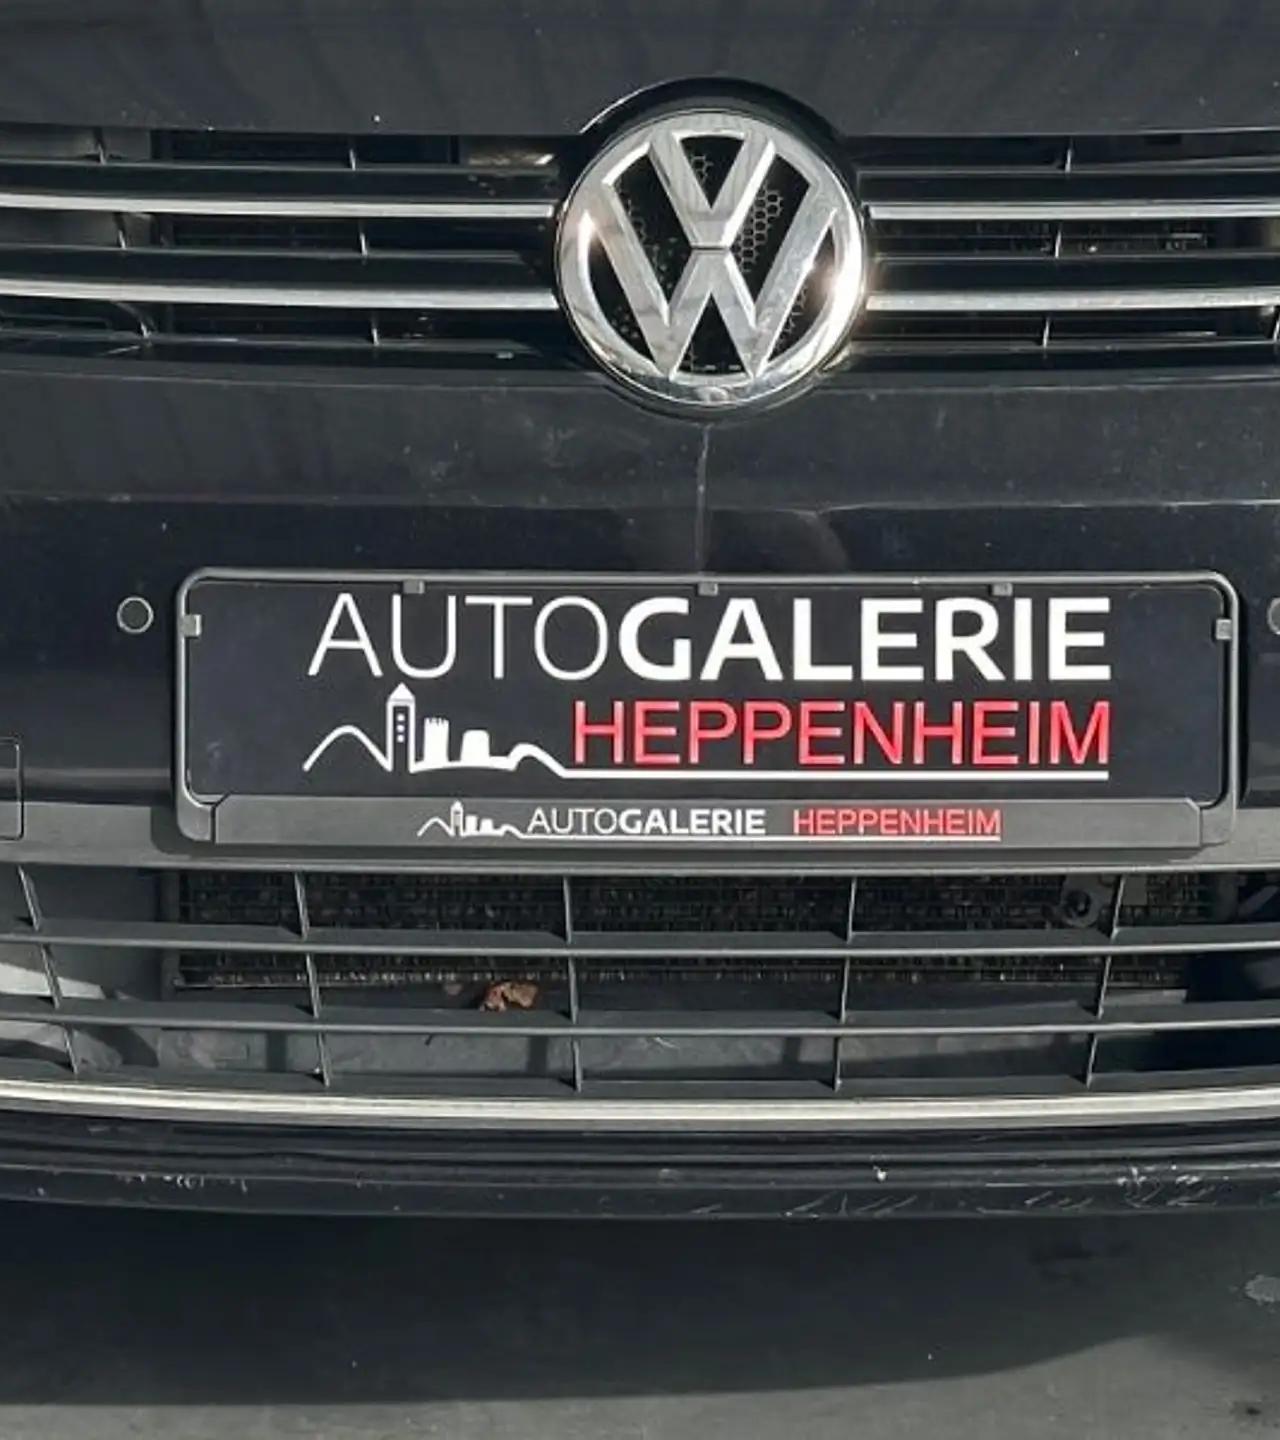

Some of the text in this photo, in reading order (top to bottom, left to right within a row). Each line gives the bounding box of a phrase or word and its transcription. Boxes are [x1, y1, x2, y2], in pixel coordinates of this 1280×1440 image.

[307, 592, 1112, 682] AUTOGALERIE
[573, 699, 1112, 766] HEPPENHEIM
[526, 807, 1003, 837] AUTOGALERIE HEPPENHEIM
